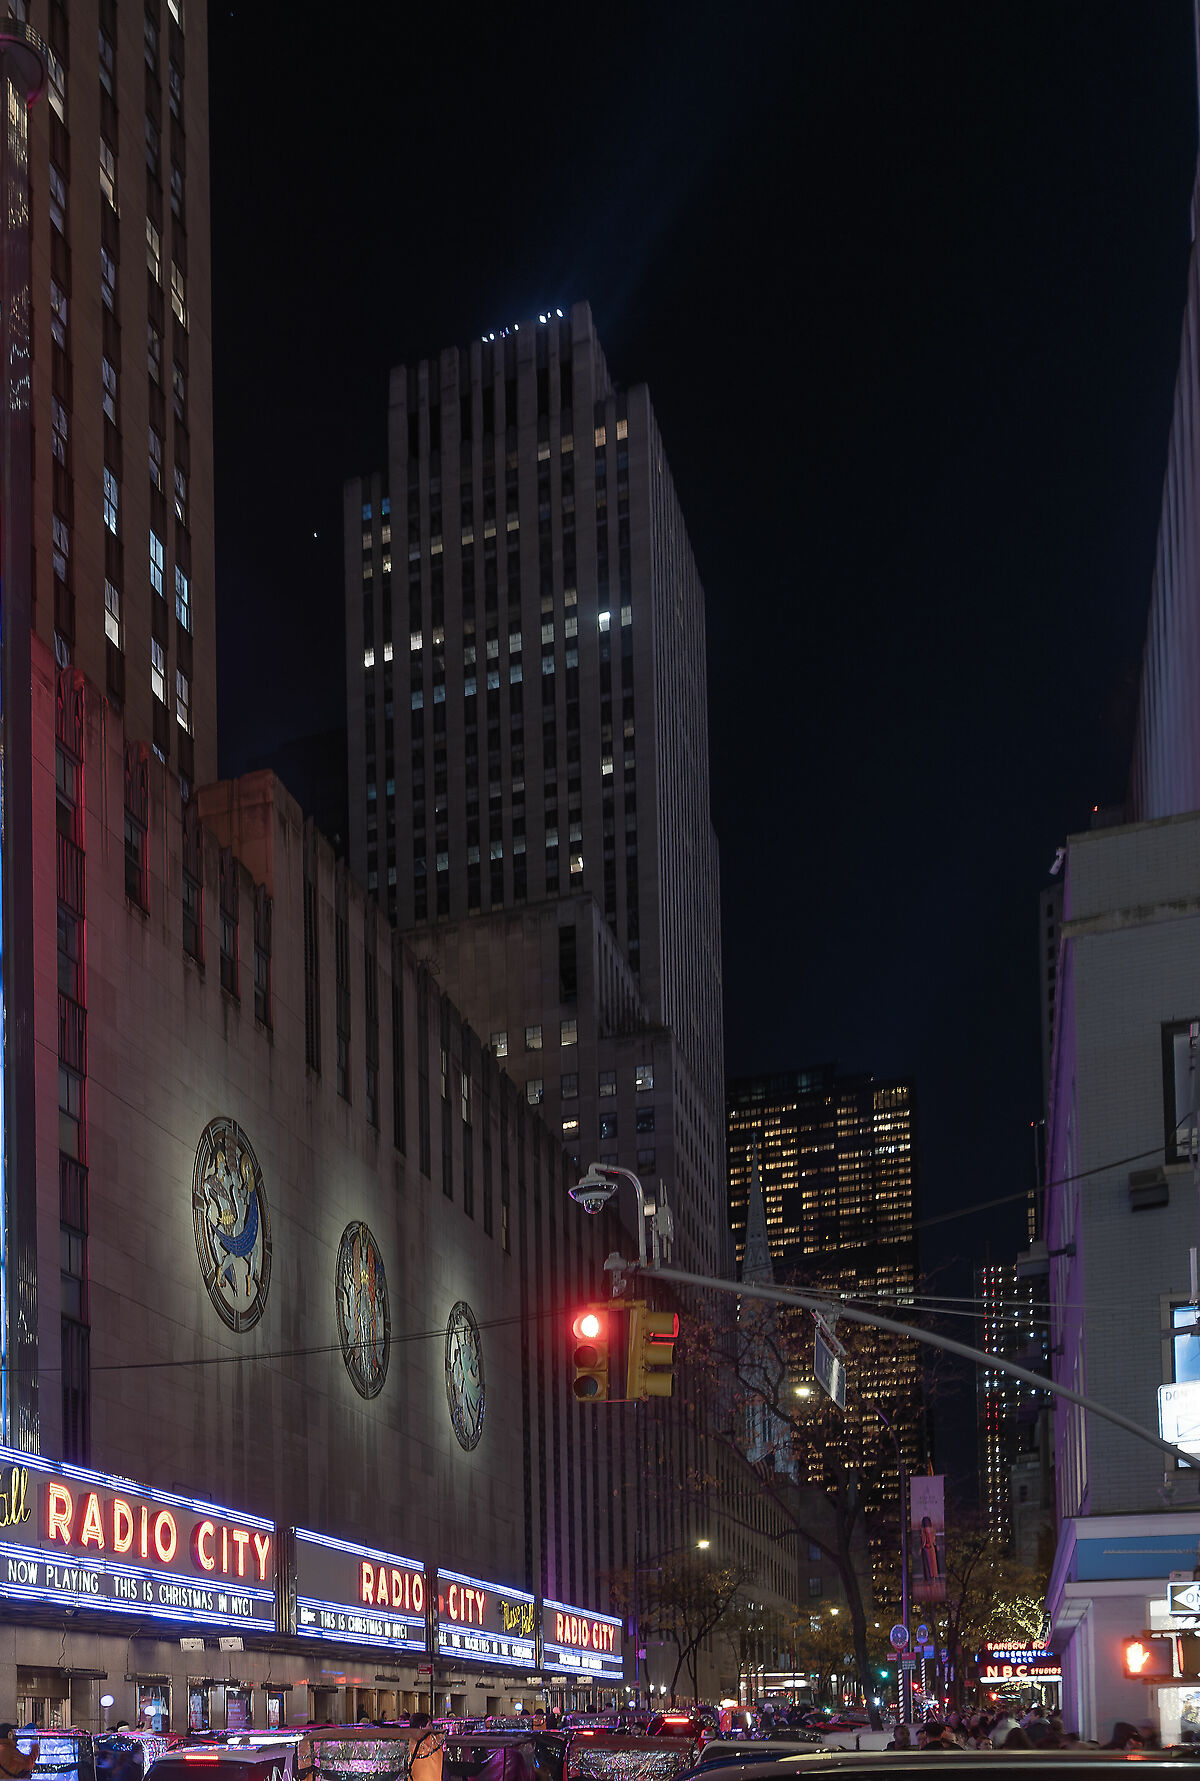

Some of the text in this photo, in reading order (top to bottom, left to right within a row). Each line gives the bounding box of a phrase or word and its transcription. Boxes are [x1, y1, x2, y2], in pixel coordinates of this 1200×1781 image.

[48, 1482, 178, 1563] RADIO
[197, 1519, 271, 1581] CITY
[7, 1558, 254, 1617] NOW PLAYING THIS IS CHRISTMAS IN NYC!
[360, 1561, 425, 1612] RADIO
[448, 1583, 486, 1626] CITY
[320, 1610, 335, 1629] THIS
[338, 1614, 346, 1631] IS
[347, 1615, 383, 1636] CHRISTMAS
[556, 1612, 615, 1652] RADIO CITY
[986, 1641, 1047, 1651] RAINBOW RO
[992, 1650, 1053, 1659] OBSERVATIO
[986, 1665, 1062, 1678] NBC STUDIOS
